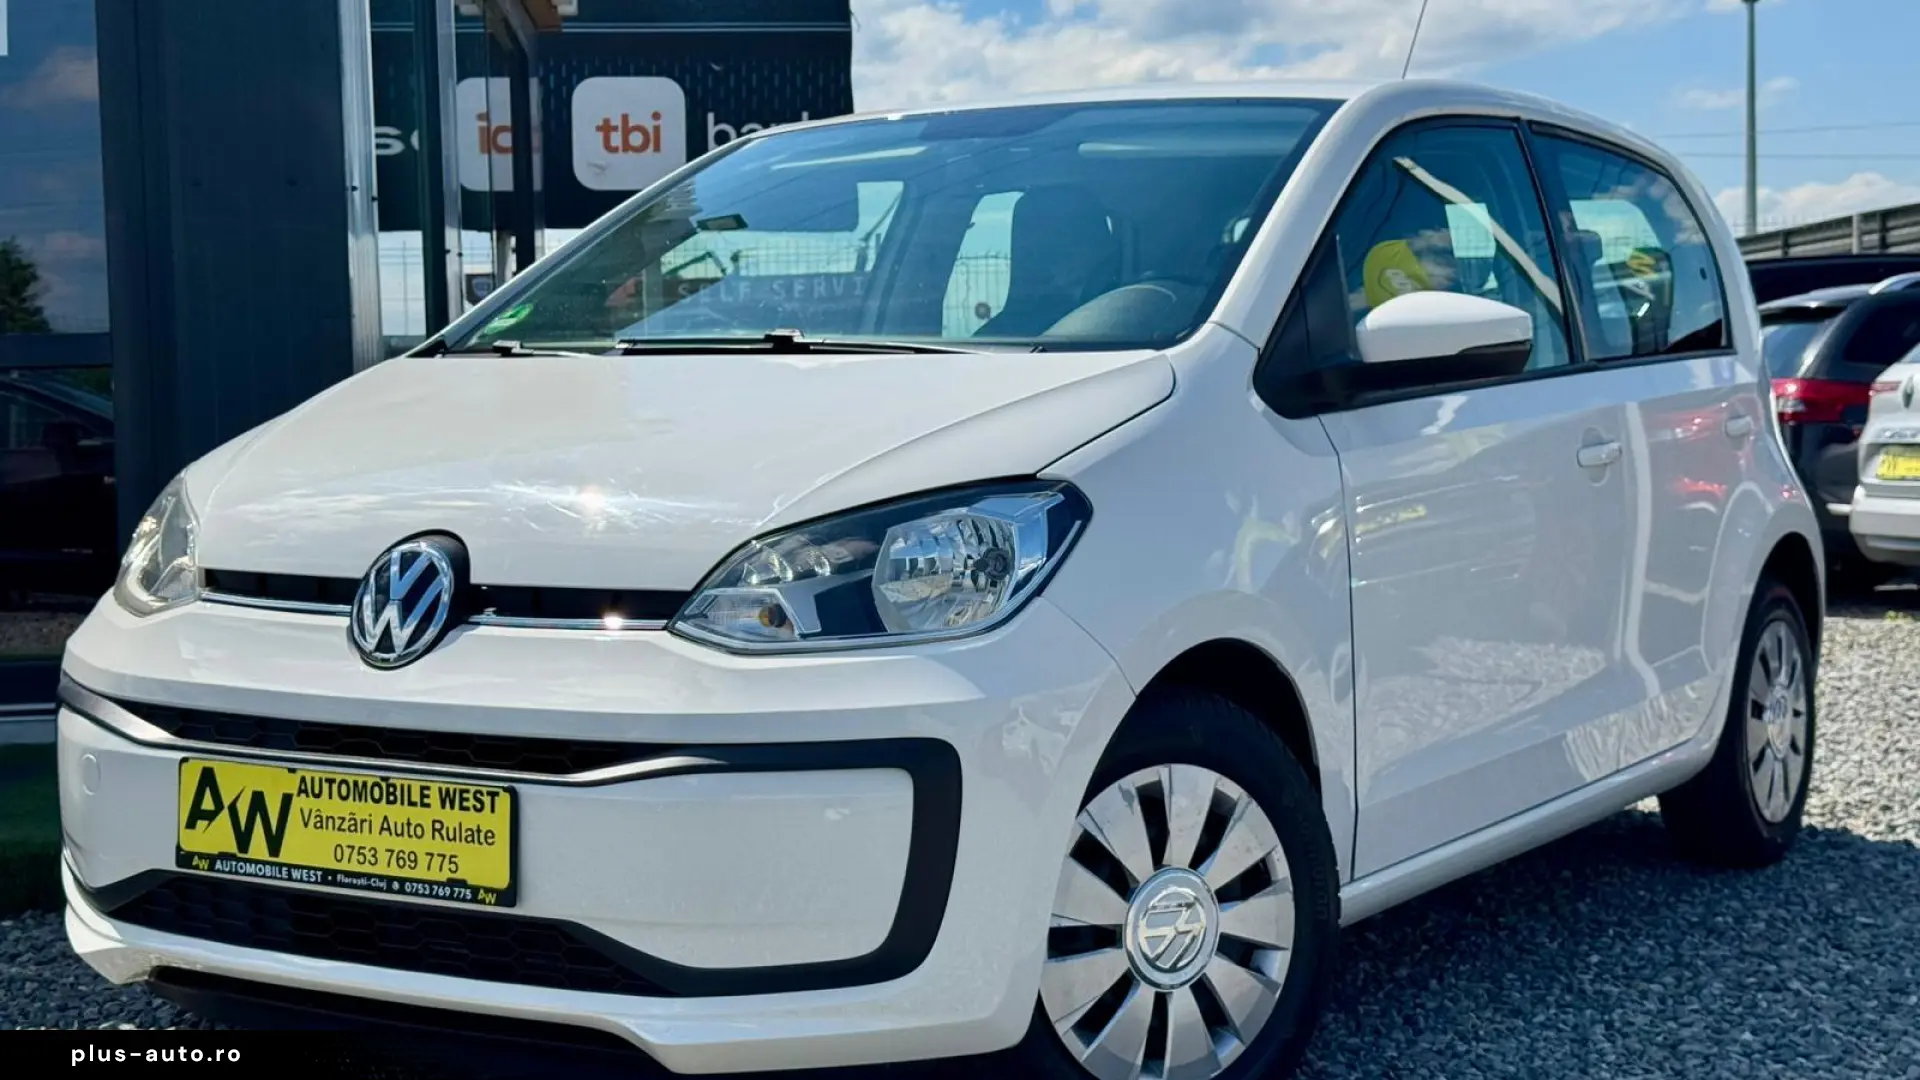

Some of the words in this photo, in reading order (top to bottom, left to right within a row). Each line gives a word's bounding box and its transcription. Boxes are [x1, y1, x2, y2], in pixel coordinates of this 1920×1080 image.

[595, 111, 662, 154] tbi
[296, 775, 431, 809] AUTOMOBILE
[438, 786, 500, 814] WEST
[379, 815, 425, 840] Auto
[432, 819, 496, 846] Rulate
[334, 843, 378, 867] 0753
[385, 848, 418, 871] 769
[425, 852, 459, 874] 775
[214, 859, 289, 879] AUTOMOBILE
[290, 868, 323, 883] WEST
[404, 882, 429, 896] 0753
[432, 884, 451, 897] 769
[453, 887, 472, 900] 775
